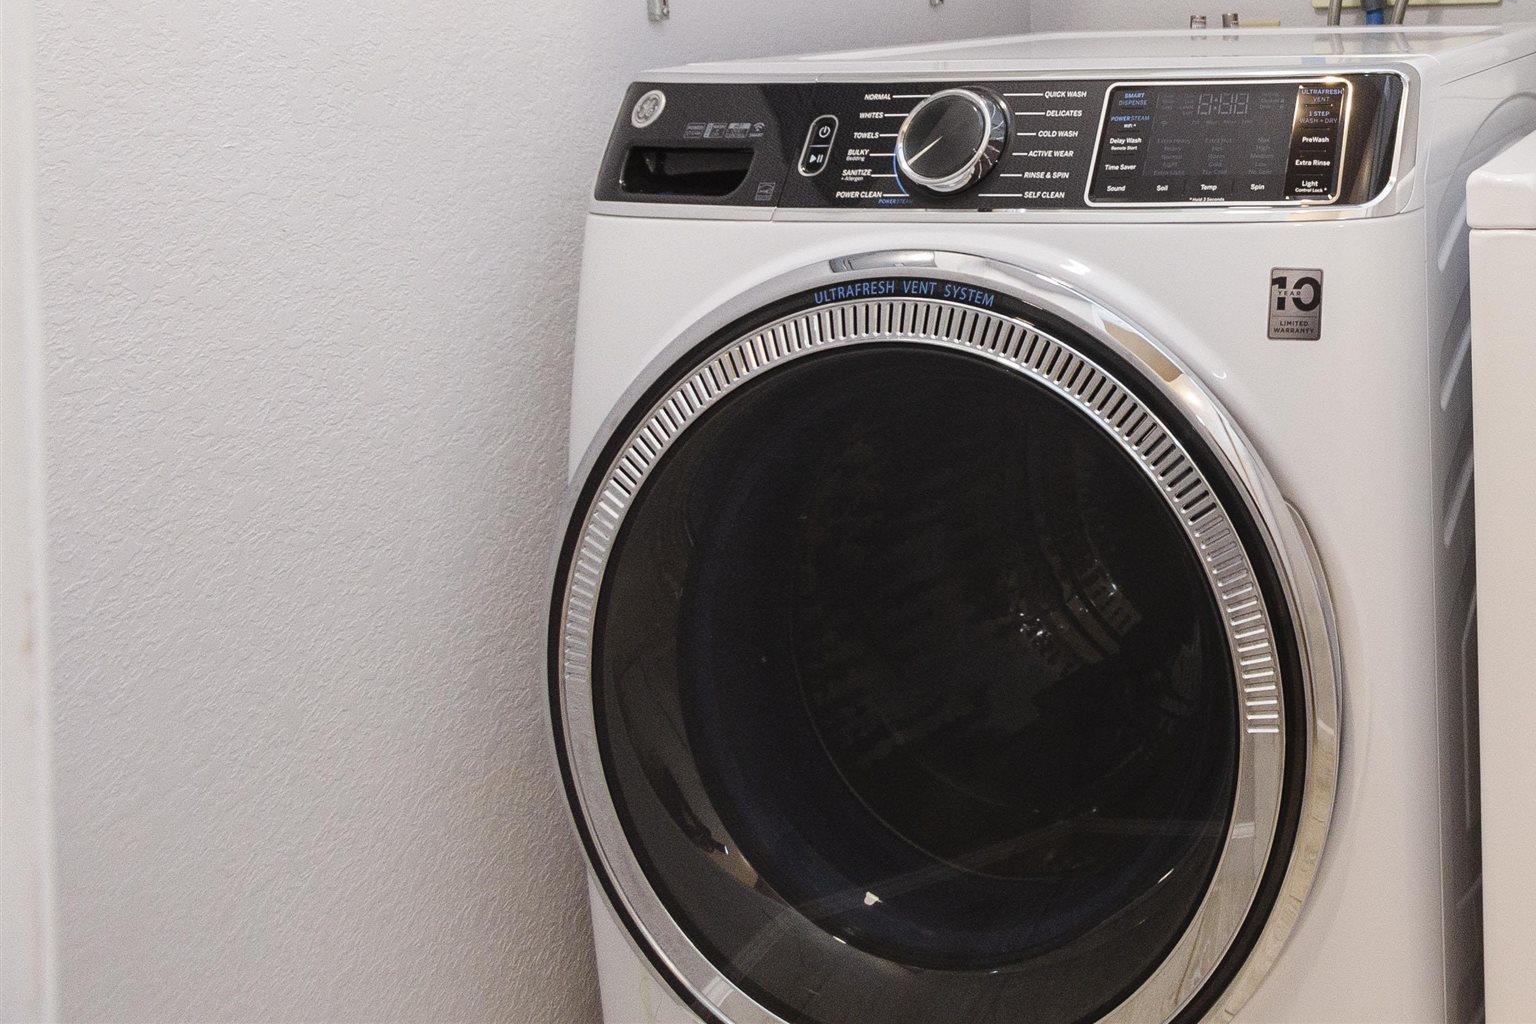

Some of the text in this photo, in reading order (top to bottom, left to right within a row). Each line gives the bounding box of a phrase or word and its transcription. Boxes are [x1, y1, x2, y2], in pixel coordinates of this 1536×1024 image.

[1109, 137, 1125, 145] Delay
[1250, 183, 1265, 191] Spin
[814, 280, 996, 308] ULTRAFRESH VENT SYSTEM
[1271, 276, 1321, 312] 10
